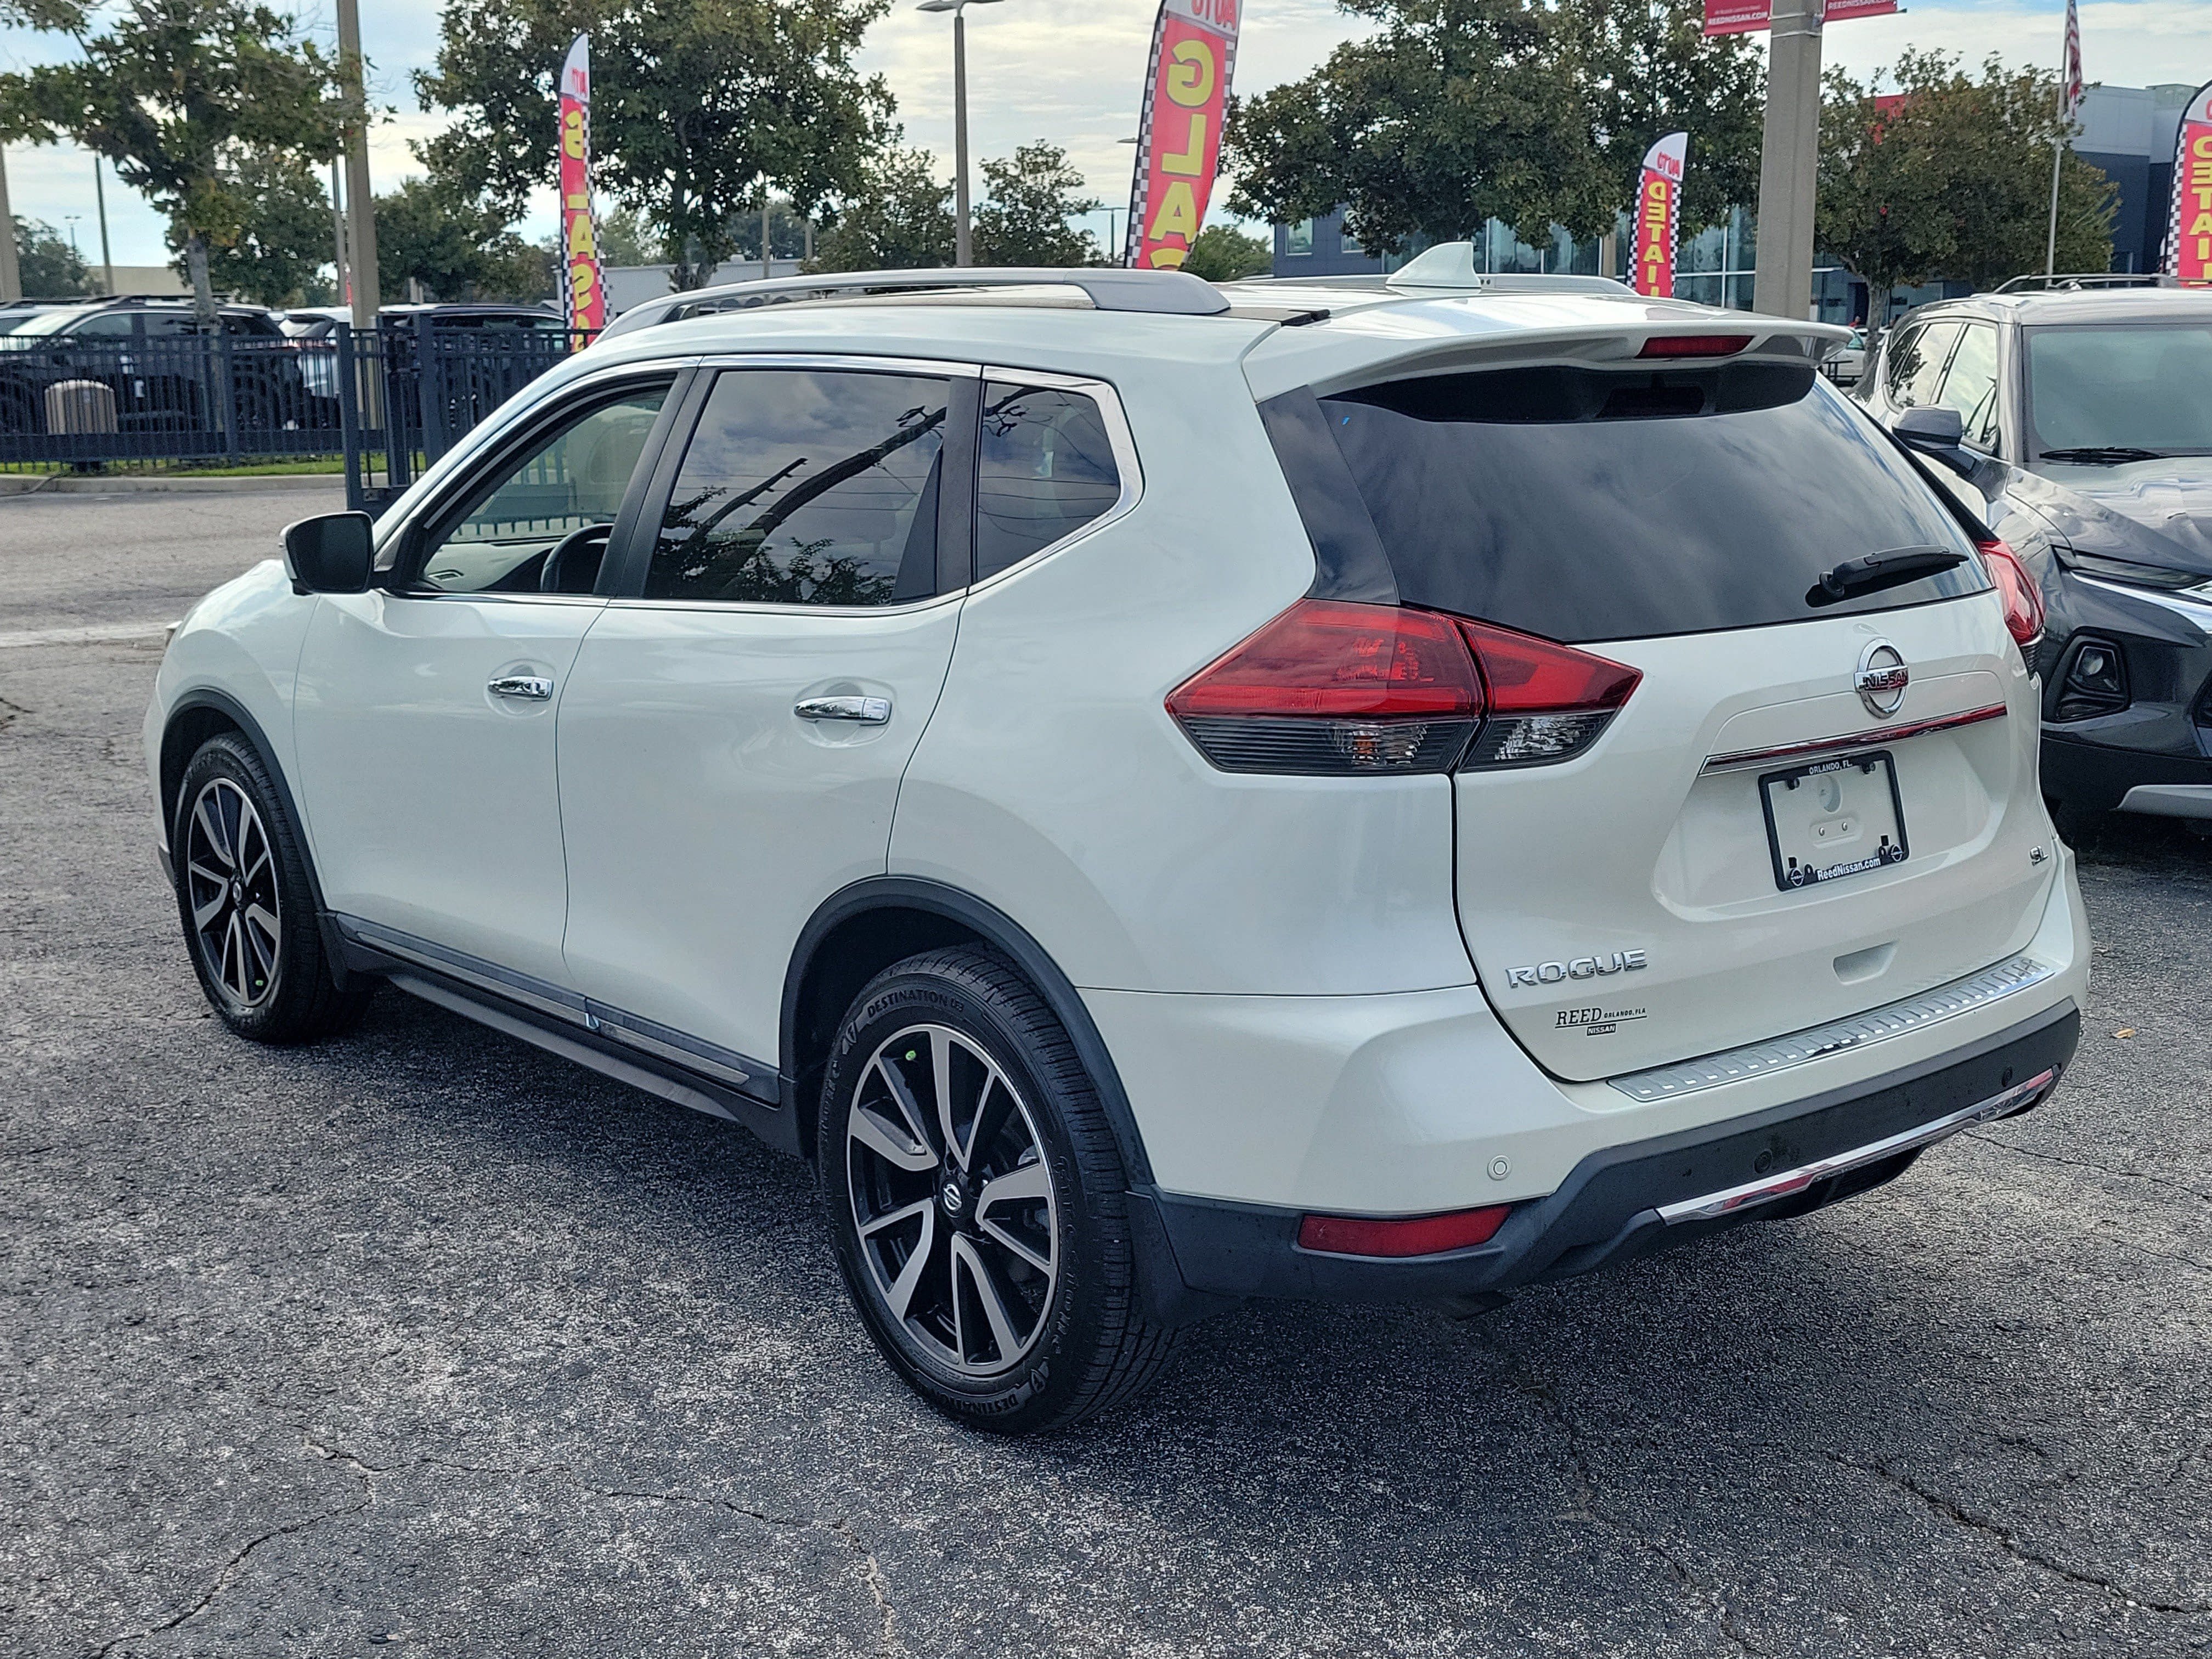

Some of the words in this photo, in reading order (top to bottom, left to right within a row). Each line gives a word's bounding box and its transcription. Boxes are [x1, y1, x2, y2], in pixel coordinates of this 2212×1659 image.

[1863, 669, 1908, 689] NISSAN
[1809, 763, 1842, 775] ORLANDO,
[1816, 857, 1881, 881] ReedNissan.com
[1505, 948, 1647, 989] ROGUE
[867, 989, 948, 1018] DESTINATION
[1556, 1007, 1602, 1026] REED
[1587, 1024, 1615, 1036] NISSAN
